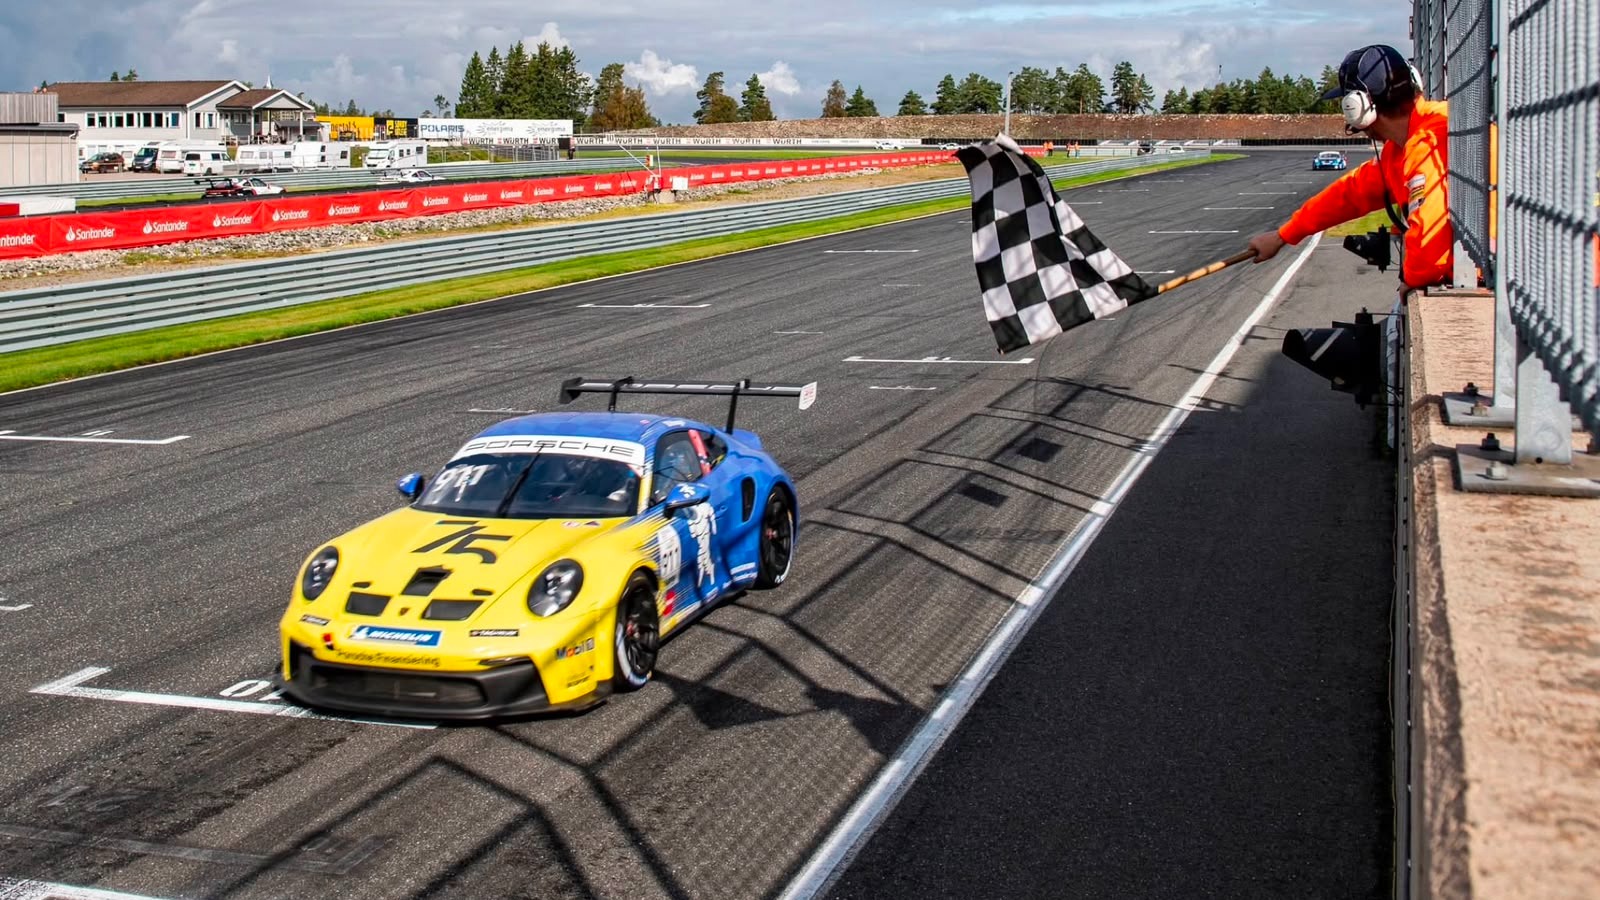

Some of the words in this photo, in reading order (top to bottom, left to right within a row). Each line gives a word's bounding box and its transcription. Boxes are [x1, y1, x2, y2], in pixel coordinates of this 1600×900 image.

[421, 124, 465, 133] POLARIS
[279, 209, 309, 221] Santander
[335, 204, 361, 216] Santander
[221, 214, 253, 227] Santander
[153, 221, 189, 233] Santander
[0, 233, 37, 247] ntander
[75, 227, 116, 241] Santander
[464, 439, 636, 458] PORSCHE
[410, 520, 514, 565] 75
[368, 630, 433, 642] MICHELIN
